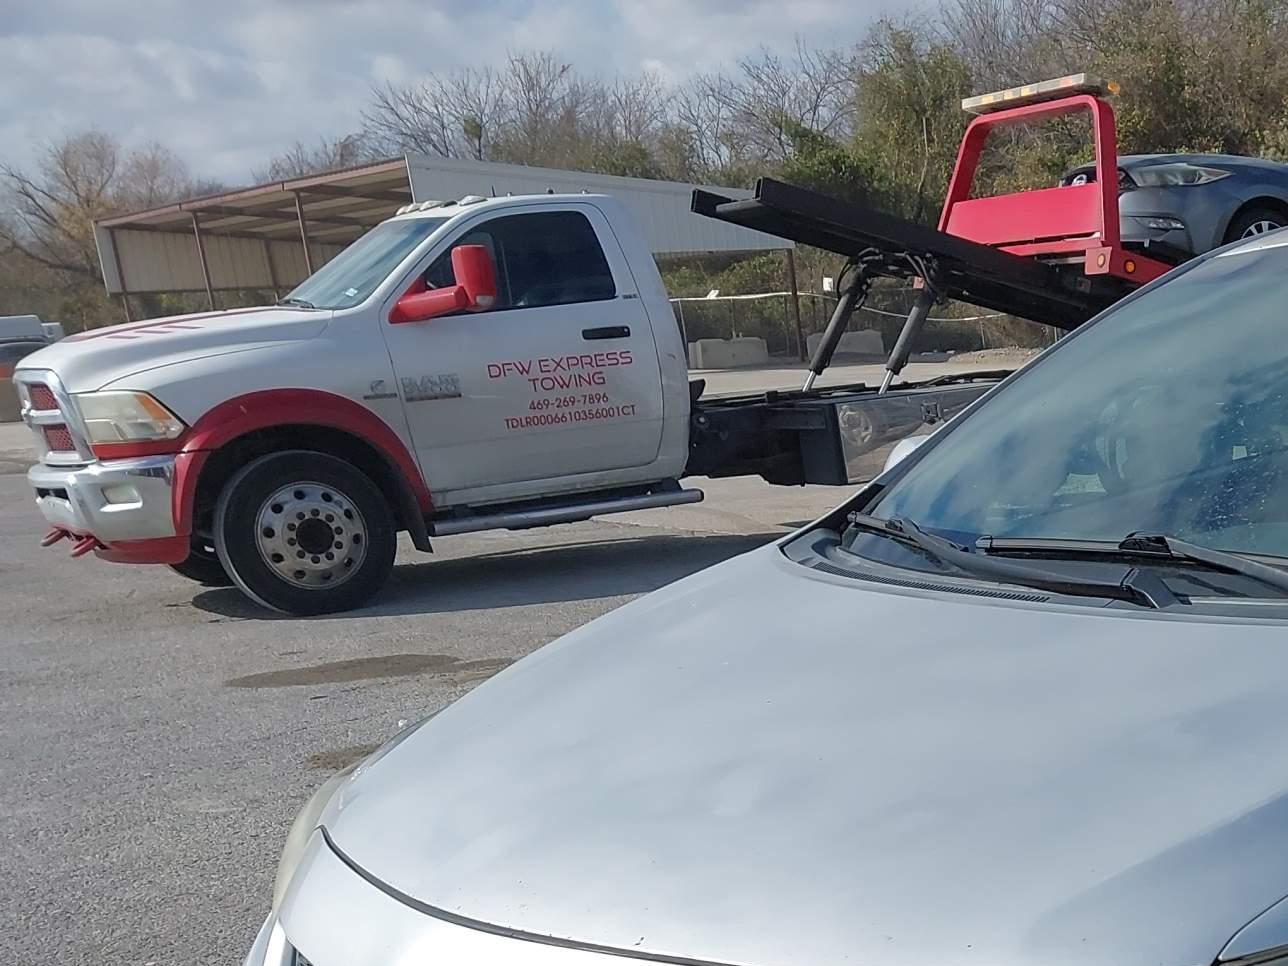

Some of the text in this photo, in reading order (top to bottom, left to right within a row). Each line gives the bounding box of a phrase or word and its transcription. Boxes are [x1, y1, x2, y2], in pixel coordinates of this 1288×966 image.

[487, 351, 633, 379] DFW EXPRESS
[528, 371, 606, 392] TOWING
[529, 392, 609, 411] 469-269-7896
